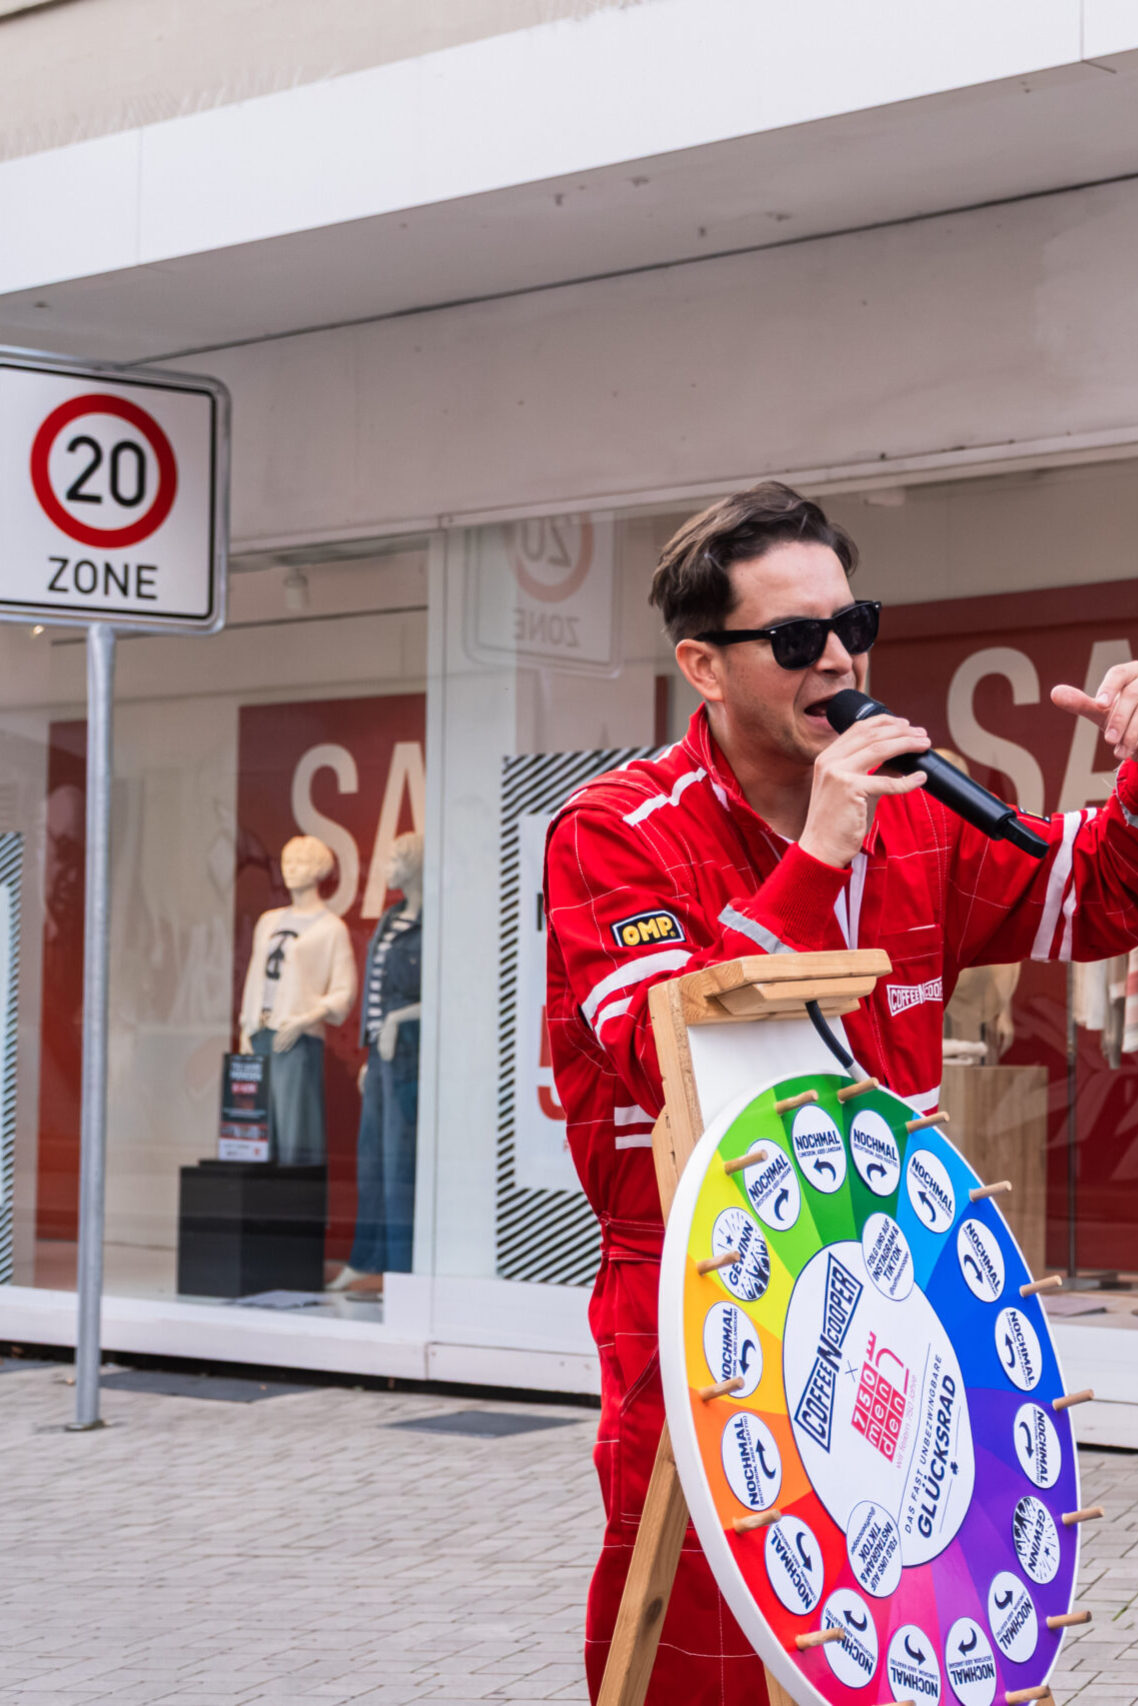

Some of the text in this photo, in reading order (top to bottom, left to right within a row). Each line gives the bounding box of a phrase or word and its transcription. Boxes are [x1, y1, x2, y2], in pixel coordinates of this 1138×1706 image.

[66, 435, 146, 508] 20
[47, 555, 158, 600] ZONE
[622, 916, 673, 946] OMP
[795, 1130, 840, 1150] NOCHMAL
[853, 1128, 898, 1161] NOCHMAL
[749, 1154, 788, 1201] NOCHMAL
[912, 1157, 953, 1213] NOCHMAL
[729, 1220, 754, 1286] GEWINN
[867, 1218, 890, 1268] FOLG UNS AUF
[872, 1231, 897, 1282] INSTAGRAM
[883, 1244, 902, 1281] TIKTOK
[966, 1222, 1000, 1292] NOCHMAL
[722, 1307, 733, 1383] NOCHMAL
[802, 1364, 833, 1440] COFFEE
[827, 1266, 857, 1342] COOPER
[1010, 1311, 1035, 1387] NOCHMAL
[854, 1369, 875, 1428] 750
[869, 1383, 889, 1445] men
[884, 1397, 904, 1456] den
[734, 1417, 760, 1506] NOCHMAL
[904, 1354, 943, 1535] DAS FAST UNBEZWINGBARE
[918, 1374, 957, 1539] GLÜCKSRAD
[1037, 1411, 1048, 1483] NOCHMAL
[771, 1529, 812, 1609] NOCHMAL
[858, 1522, 881, 1564] TIKTOK
[864, 1521, 893, 1577] INSTAGRAM
[870, 1536, 898, 1592] FOLG UNS AUF
[1028, 1508, 1046, 1573] GEWINN
[999, 1597, 1033, 1650] NOCHMAL
[891, 1667, 938, 1698] NOCHMAL
[951, 1663, 995, 1685] NOCHMAL
